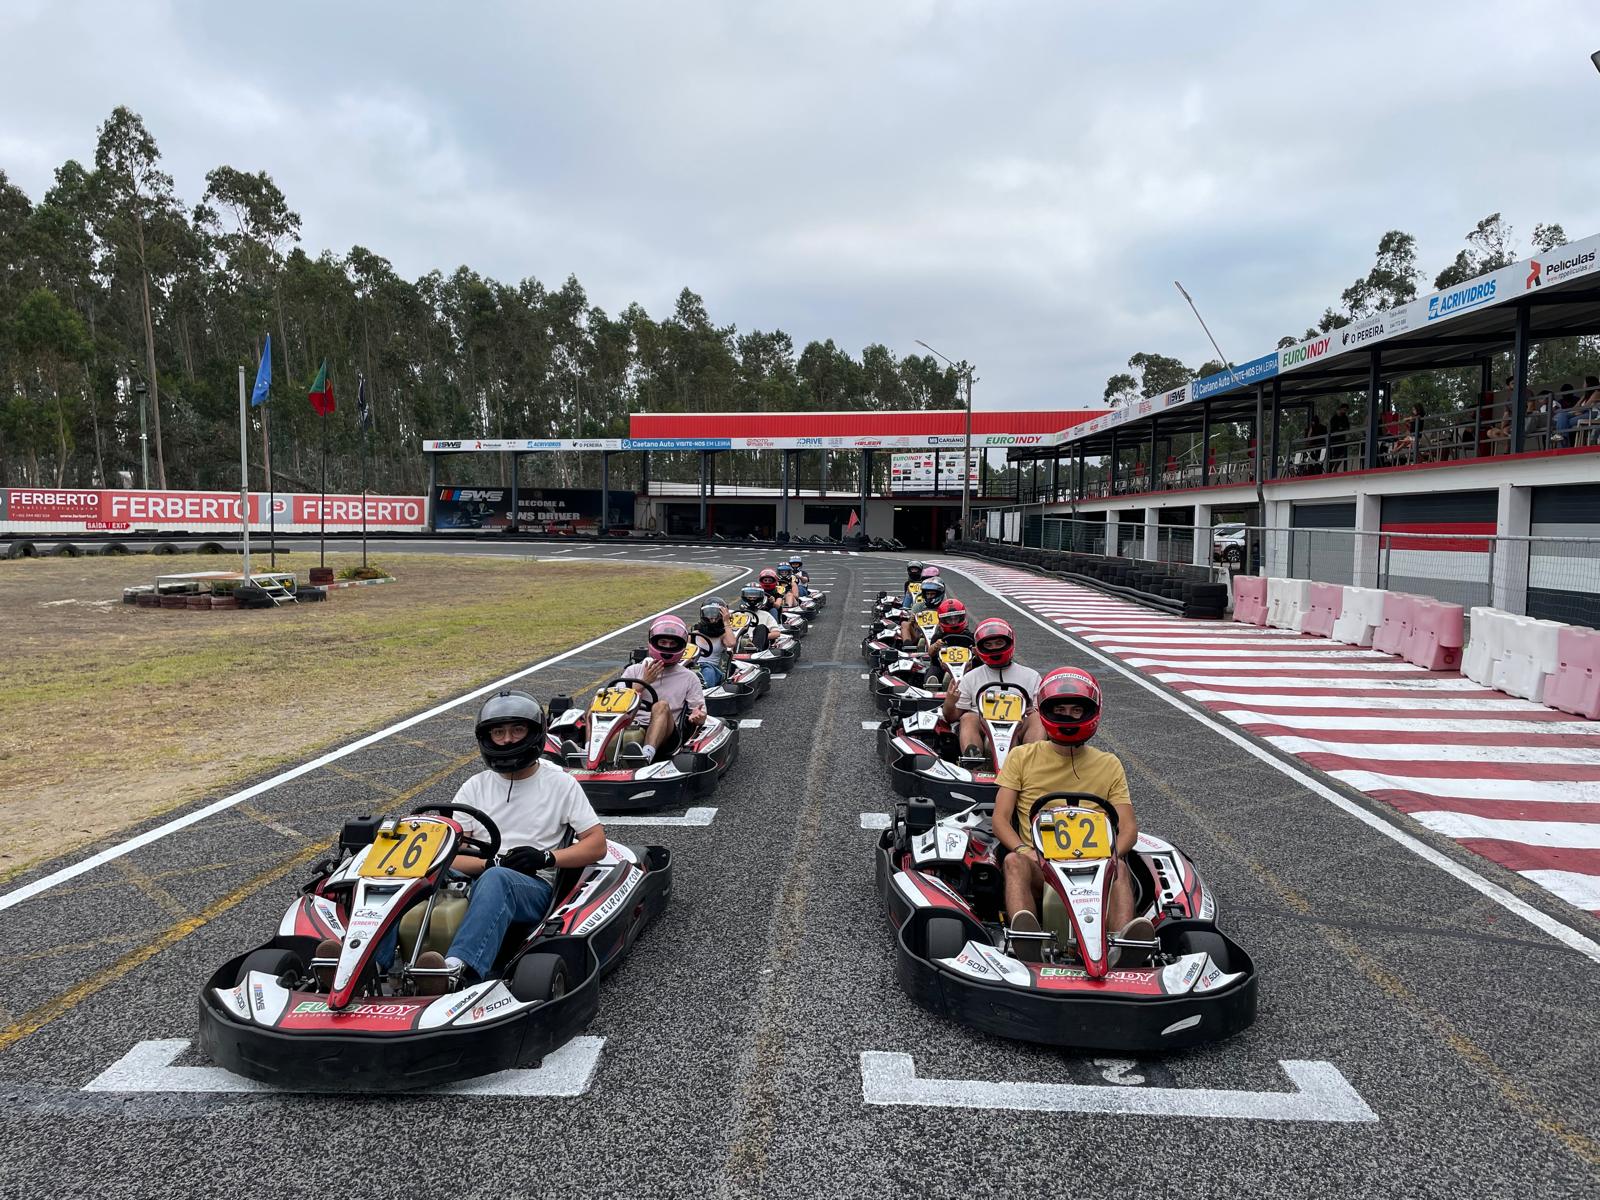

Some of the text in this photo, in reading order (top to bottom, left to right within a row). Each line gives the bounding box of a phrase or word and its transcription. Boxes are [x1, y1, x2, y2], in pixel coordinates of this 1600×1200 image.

[1440, 279, 1497, 312] ACRIVIDROS
[1350, 333, 1356, 344] O
[1357, 324, 1385, 343] PEREIRA
[1283, 337, 1331, 367] EUROINDY
[1200, 380, 1218, 395] Caetano
[1218, 376, 1230, 387] Auto
[1256, 365, 1263, 374] EM
[1263, 358, 1278, 373] LEIRIA
[632, 440, 658, 448] Caetano
[659, 440, 675, 448] Auto
[985, 436, 1042, 445] EUROINDY
[10, 492, 98, 506] FERBERTO
[112, 496, 250, 519] FERBERTO
[303, 500, 419, 521] FERBERTO
[537, 512, 580, 520] DRIVER
[922, 614, 933, 623] 64
[948, 650, 963, 661] 85
[600, 691, 626, 707] 67
[992, 700, 1013, 717] 77
[1054, 818, 1098, 850] 62
[376, 832, 428, 869] 76
[966, 959, 989, 975] SODI
[485, 997, 512, 1013] SODI
